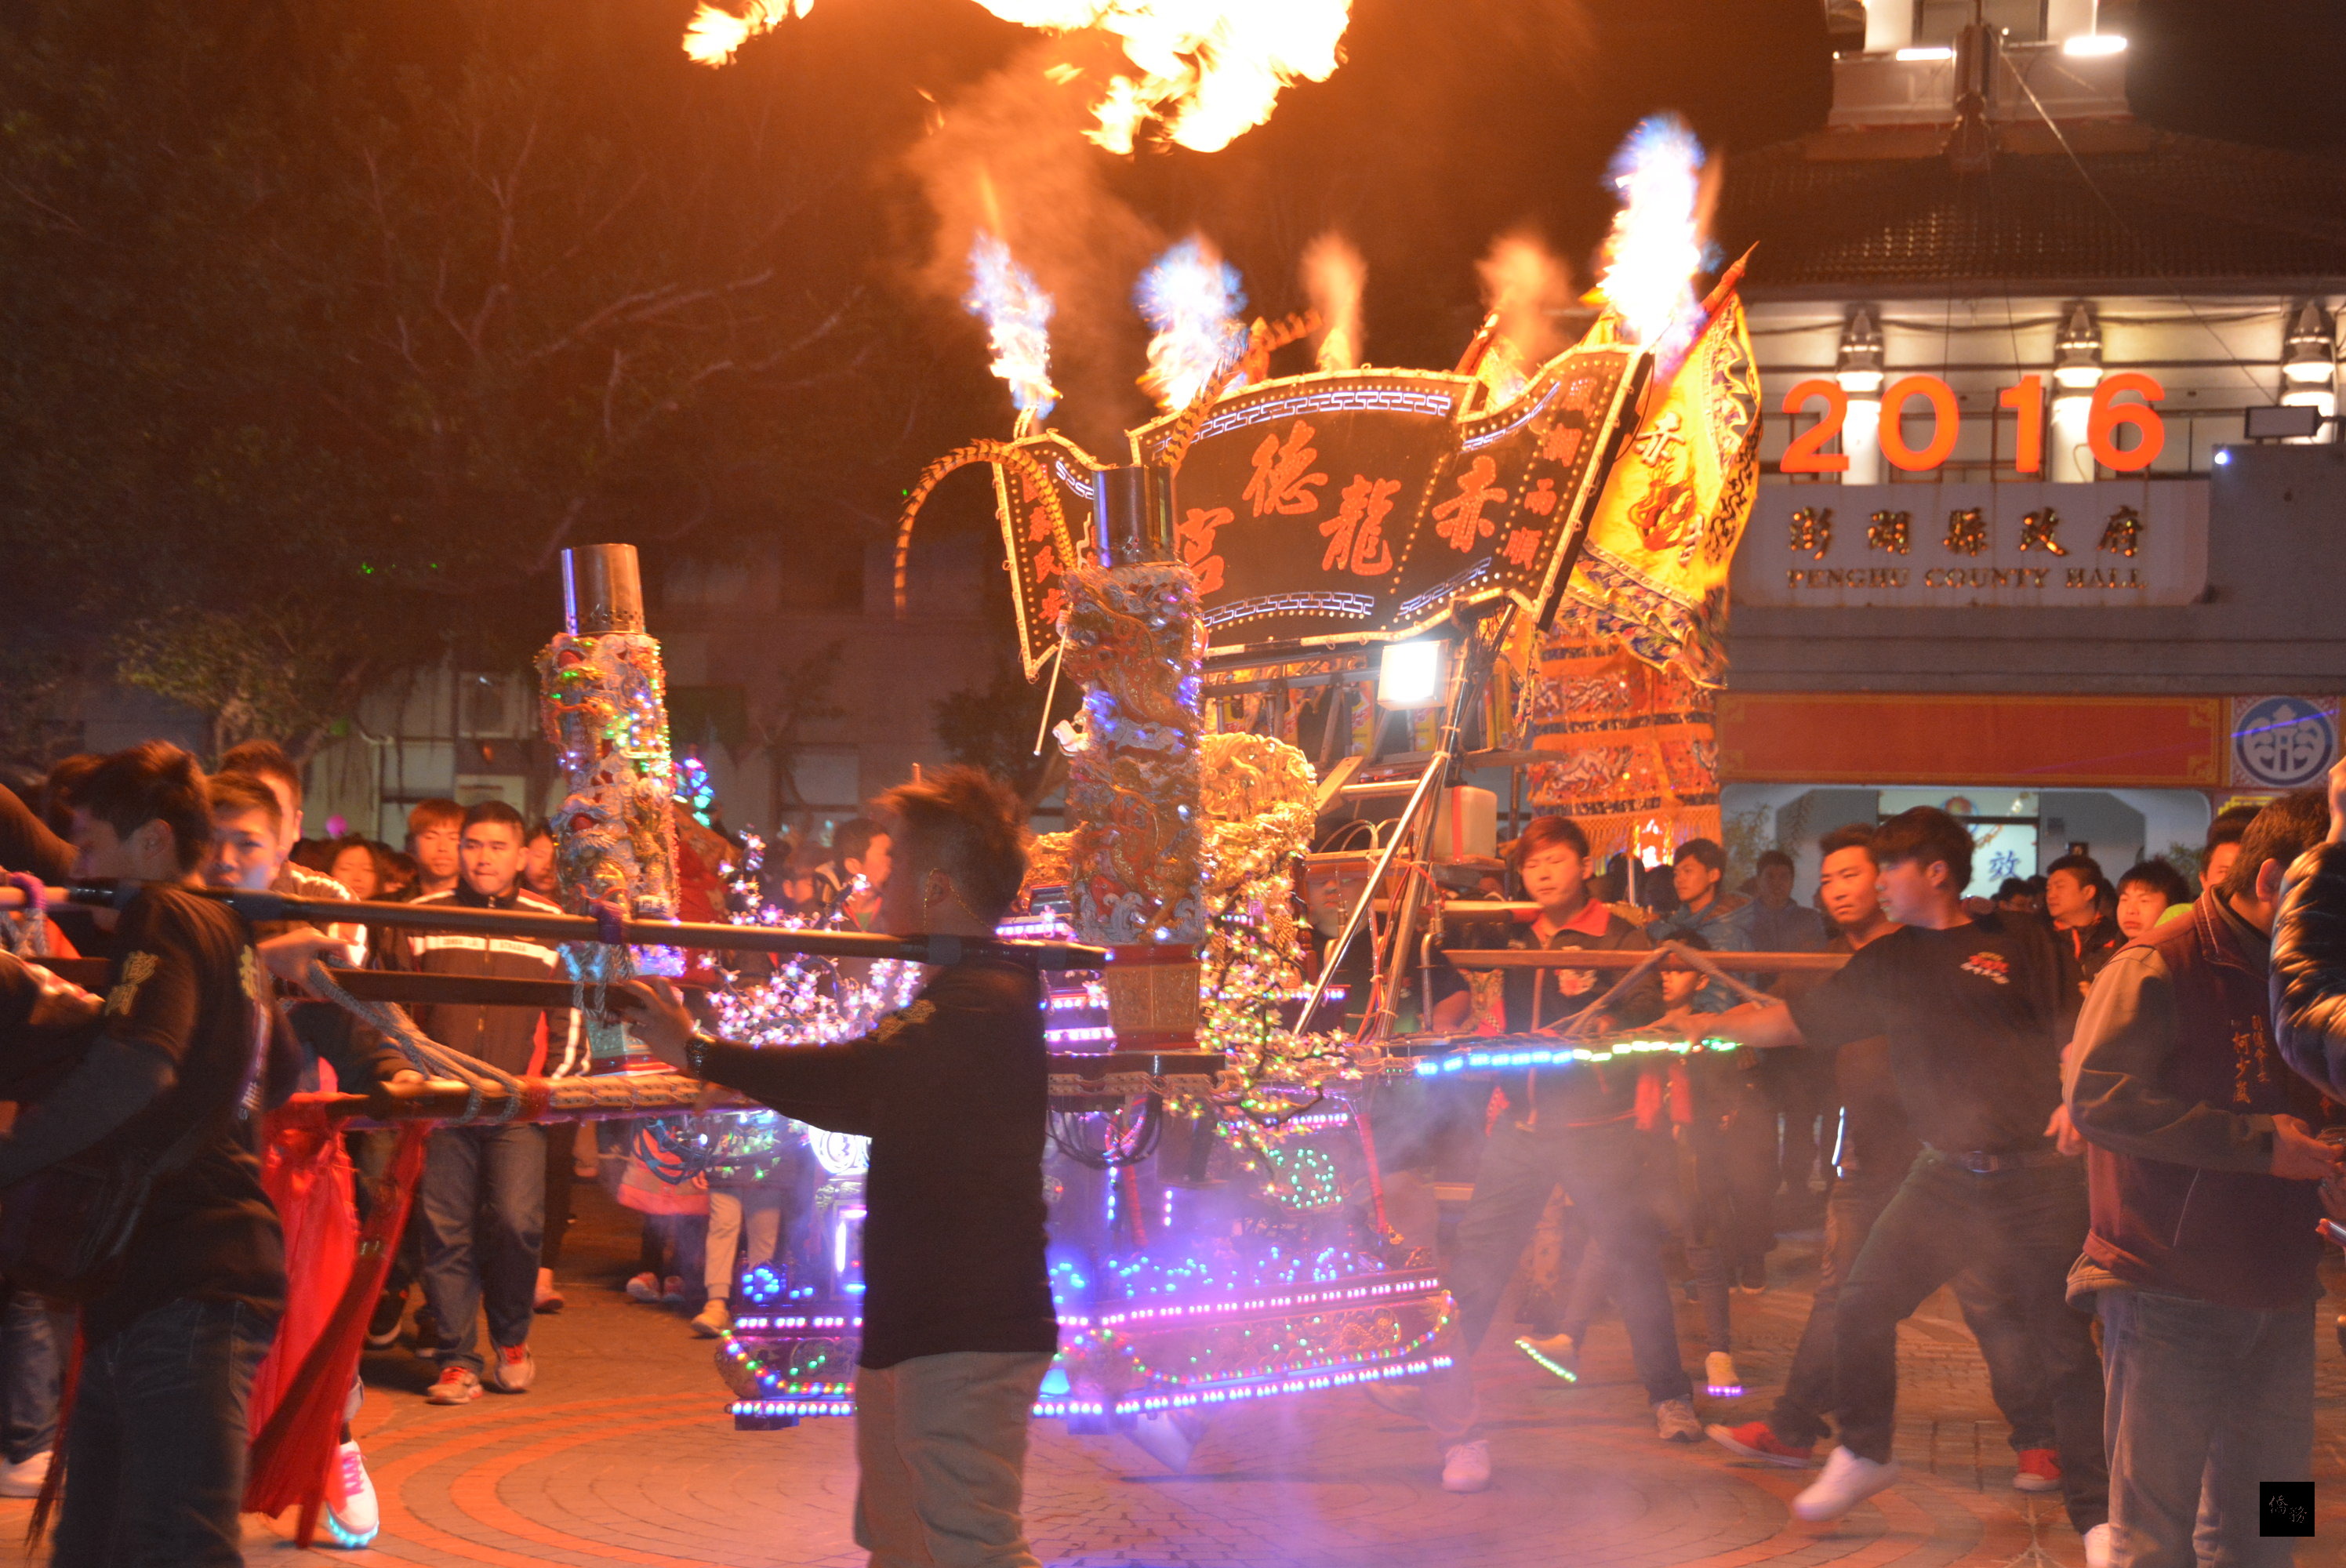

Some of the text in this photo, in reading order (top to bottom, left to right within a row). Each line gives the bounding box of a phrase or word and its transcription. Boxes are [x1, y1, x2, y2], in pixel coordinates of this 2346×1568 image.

[1637, 412, 1685, 467] 赤
[1780, 372, 2166, 473] 2016
[1786, 567, 2149, 590] PENGHU COUNTY HALL
[1989, 850, 2021, 883] 效
